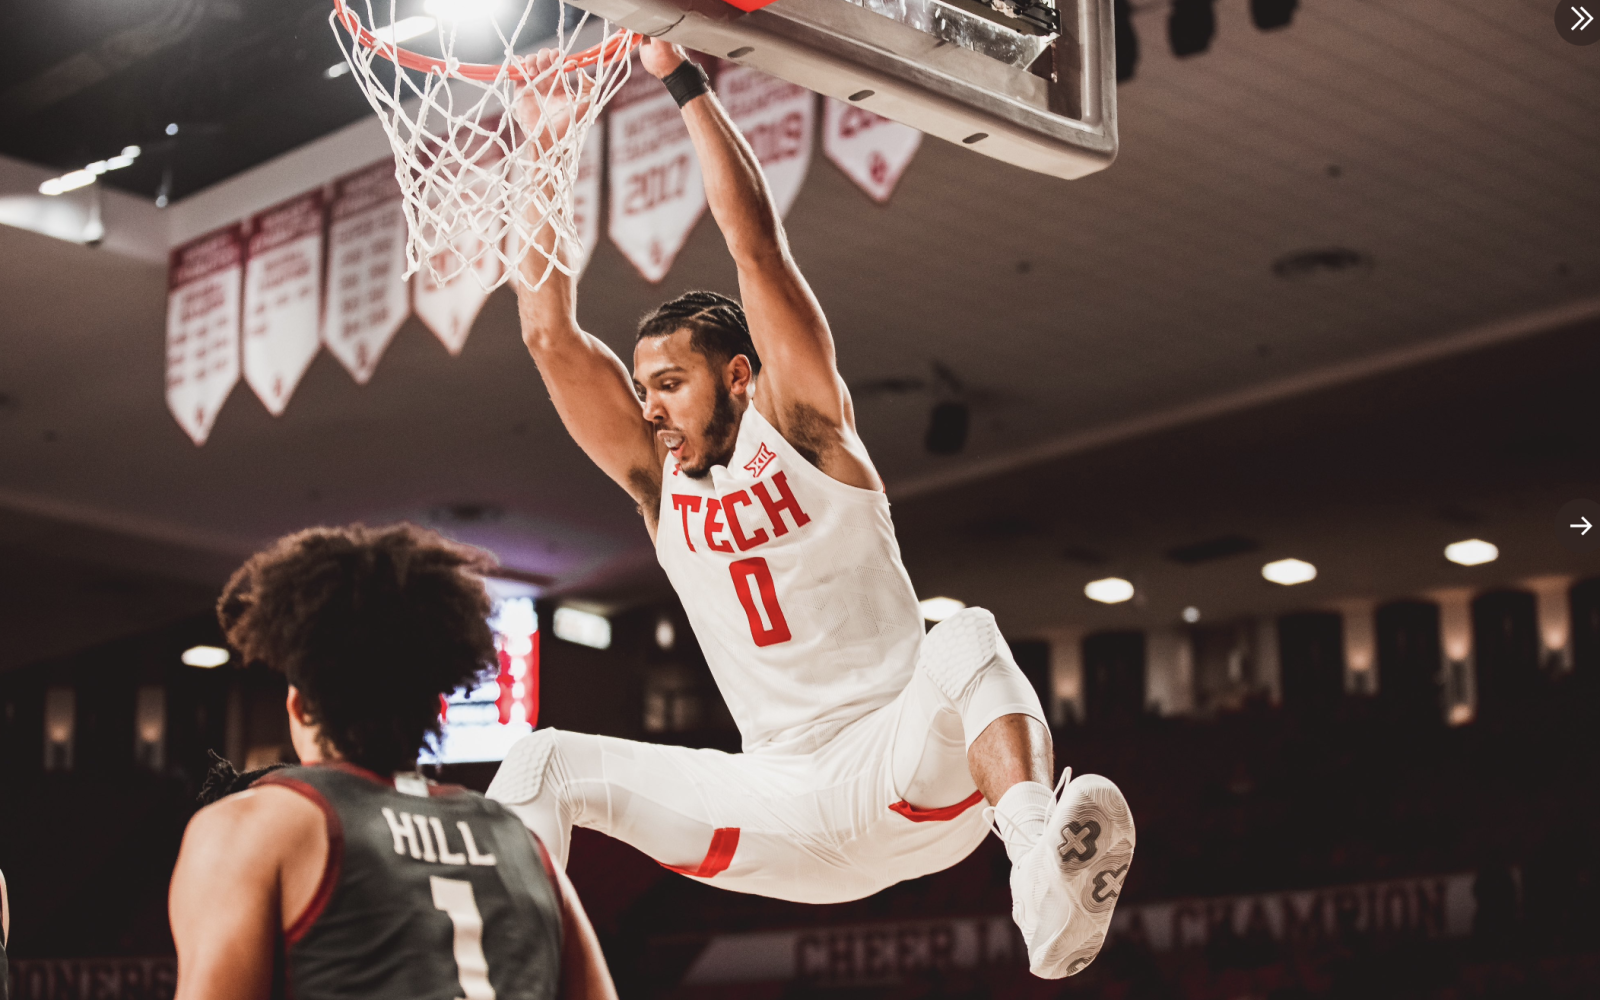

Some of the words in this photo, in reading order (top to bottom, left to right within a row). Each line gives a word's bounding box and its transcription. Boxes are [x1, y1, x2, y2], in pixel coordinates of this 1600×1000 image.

[744, 110, 804, 168] 019
[671, 470, 812, 554] TECH
[729, 556, 792, 648] 0
[381, 807, 497, 866] HILL
[429, 875, 496, 1000] 1
[796, 923, 955, 978] CHEER
[1175, 879, 1445, 951] CHAMPION
